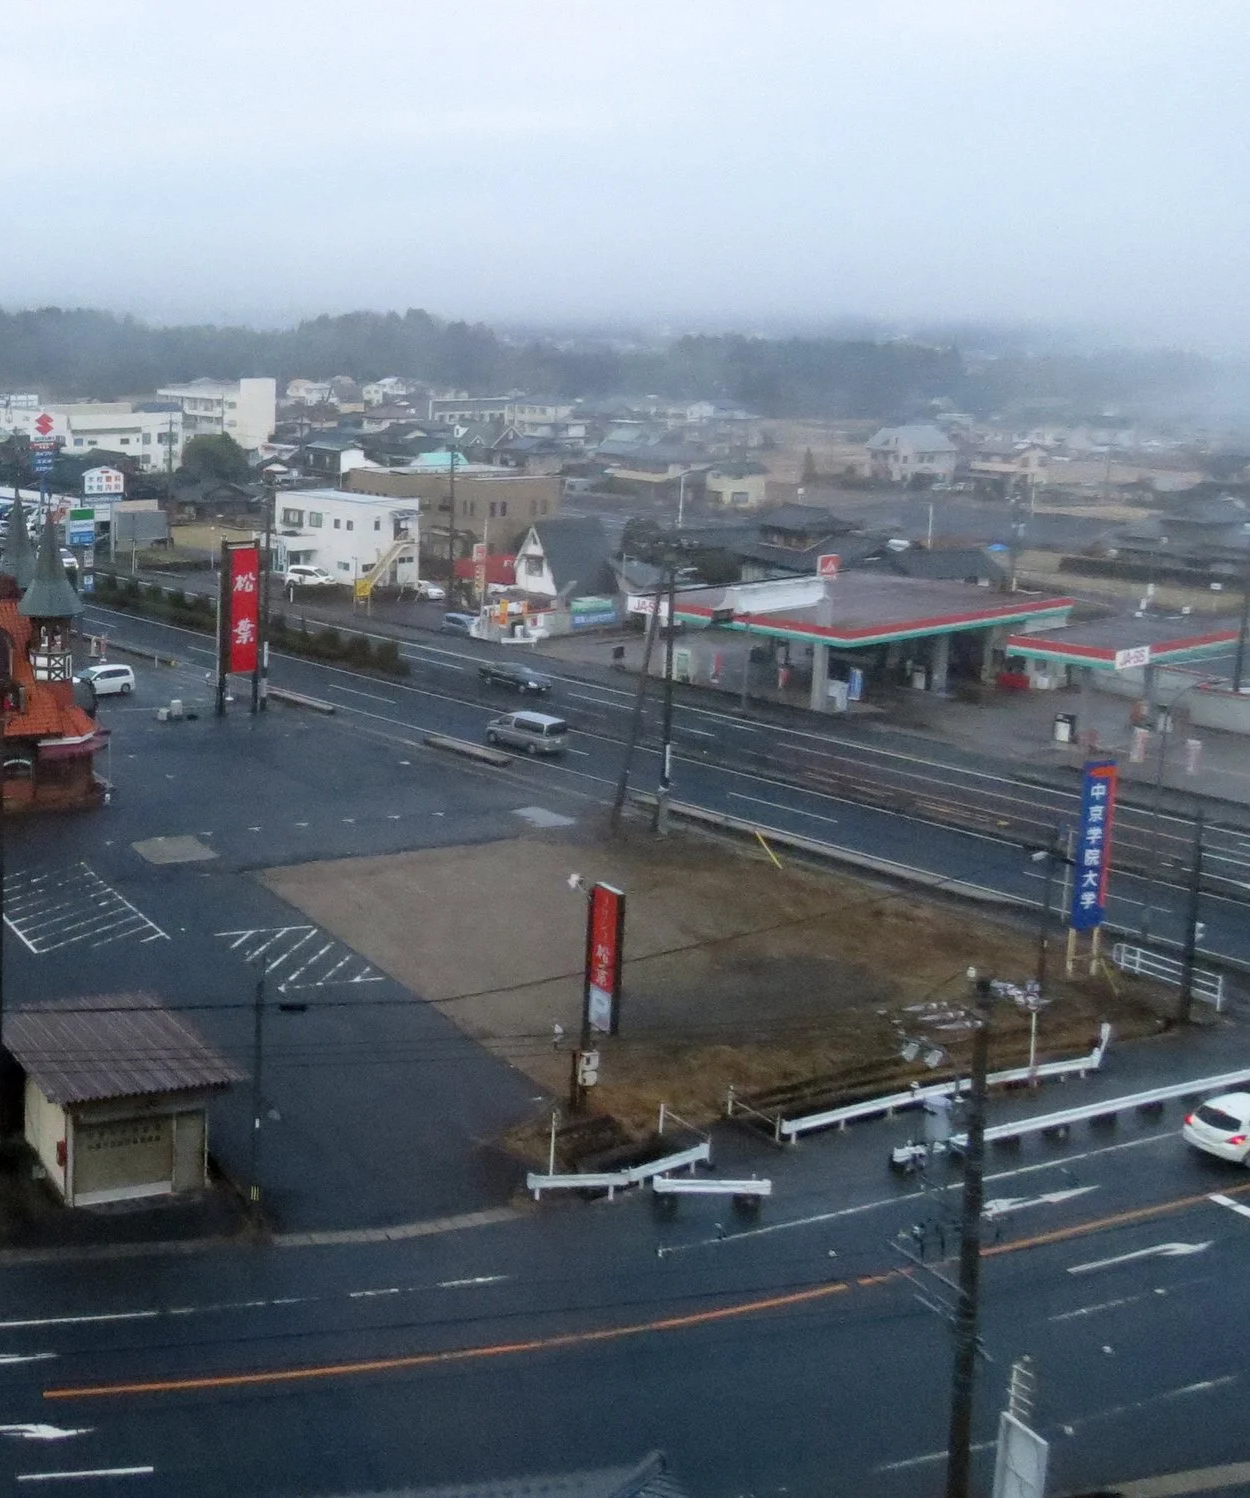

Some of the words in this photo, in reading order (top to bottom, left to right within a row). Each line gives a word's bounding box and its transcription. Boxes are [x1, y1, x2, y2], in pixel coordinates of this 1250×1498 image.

[1079, 783, 1106, 909] 中京学院大学
